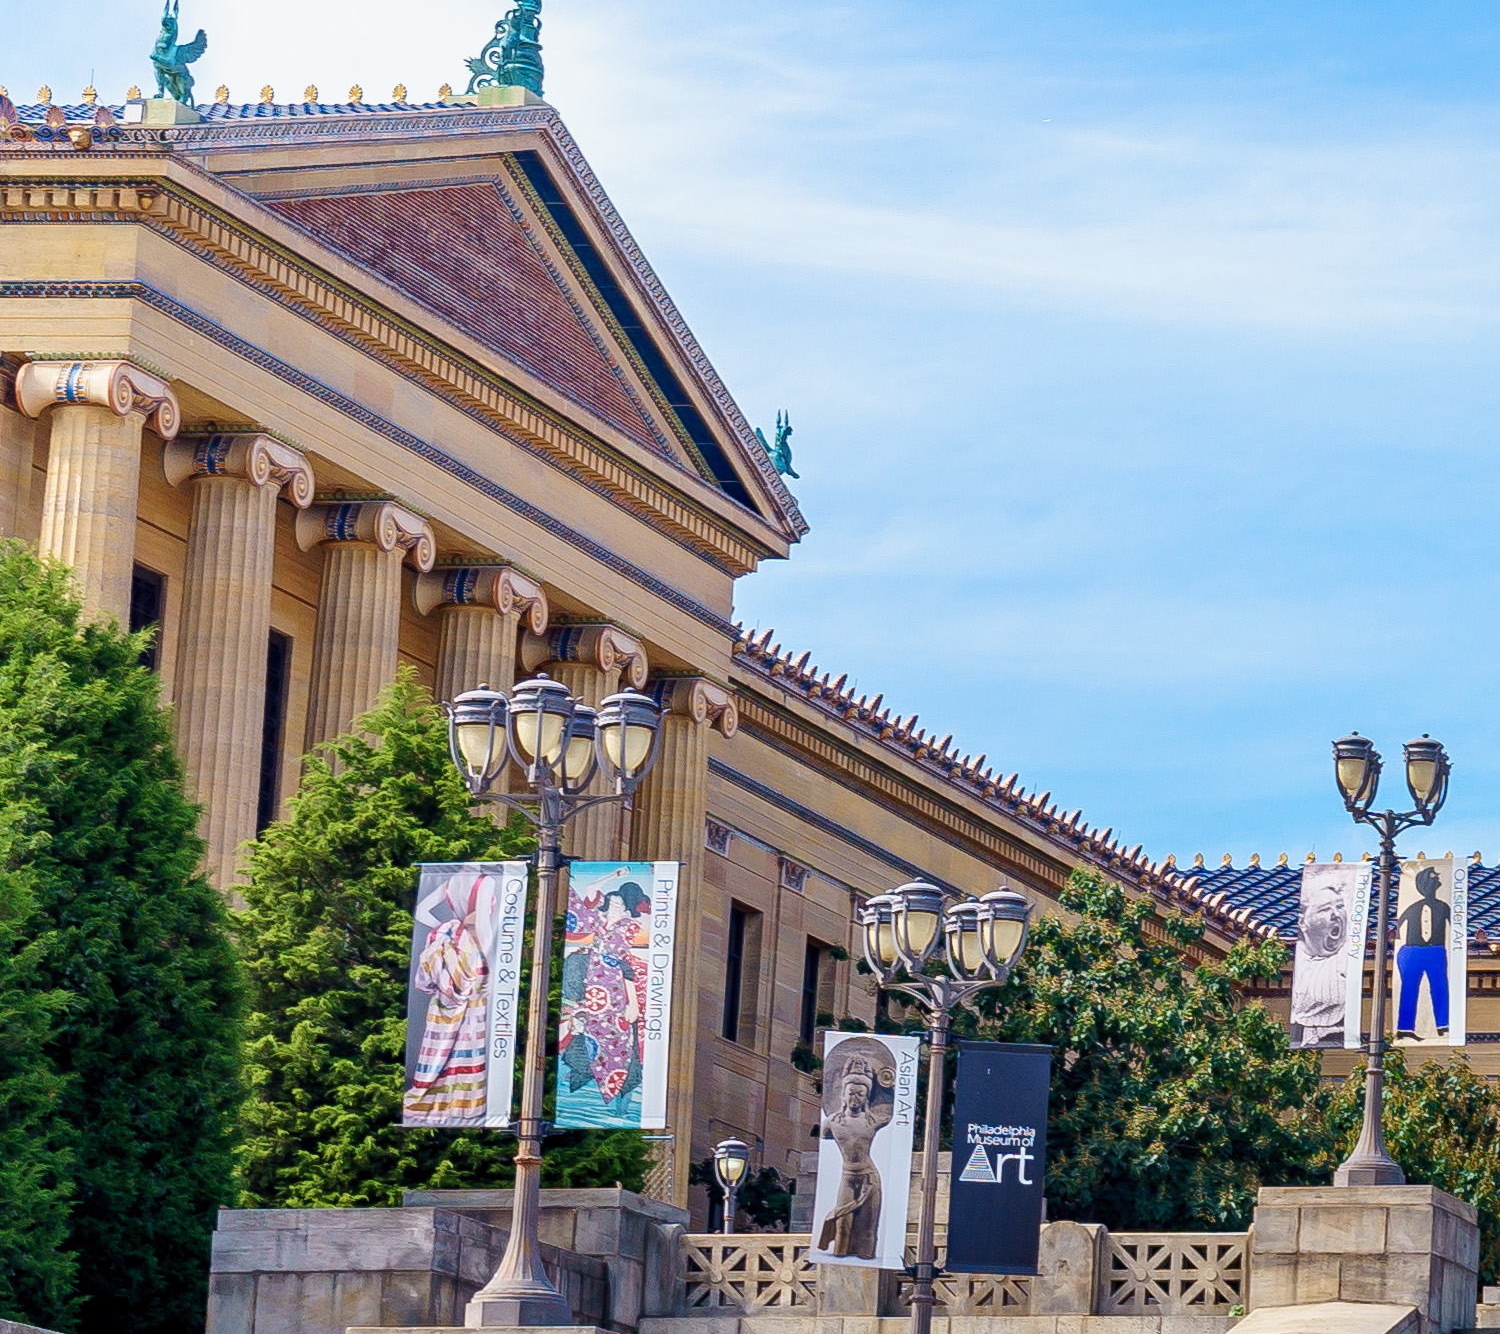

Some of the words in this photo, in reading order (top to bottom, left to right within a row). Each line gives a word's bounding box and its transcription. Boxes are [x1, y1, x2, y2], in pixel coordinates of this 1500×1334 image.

[653, 879, 674, 929] Prints
[1347, 874, 1370, 960] Photography
[1453, 869, 1466, 929] Outsider
[499, 878, 524, 964] Costume
[653, 934, 672, 948] &
[1453, 930, 1464, 952] Art
[498, 970, 517, 984] &
[643, 953, 669, 1041] Drawings
[493, 988, 516, 1059] Textiles
[898, 1051, 916, 1097] Asian
[895, 1100, 913, 1127] Art
[967, 1123, 1036, 1138] Philadelphia
[966, 1133, 1021, 1147] Museum
[1021, 1136, 1035, 1148] of
[959, 1144, 1035, 1185] Art
